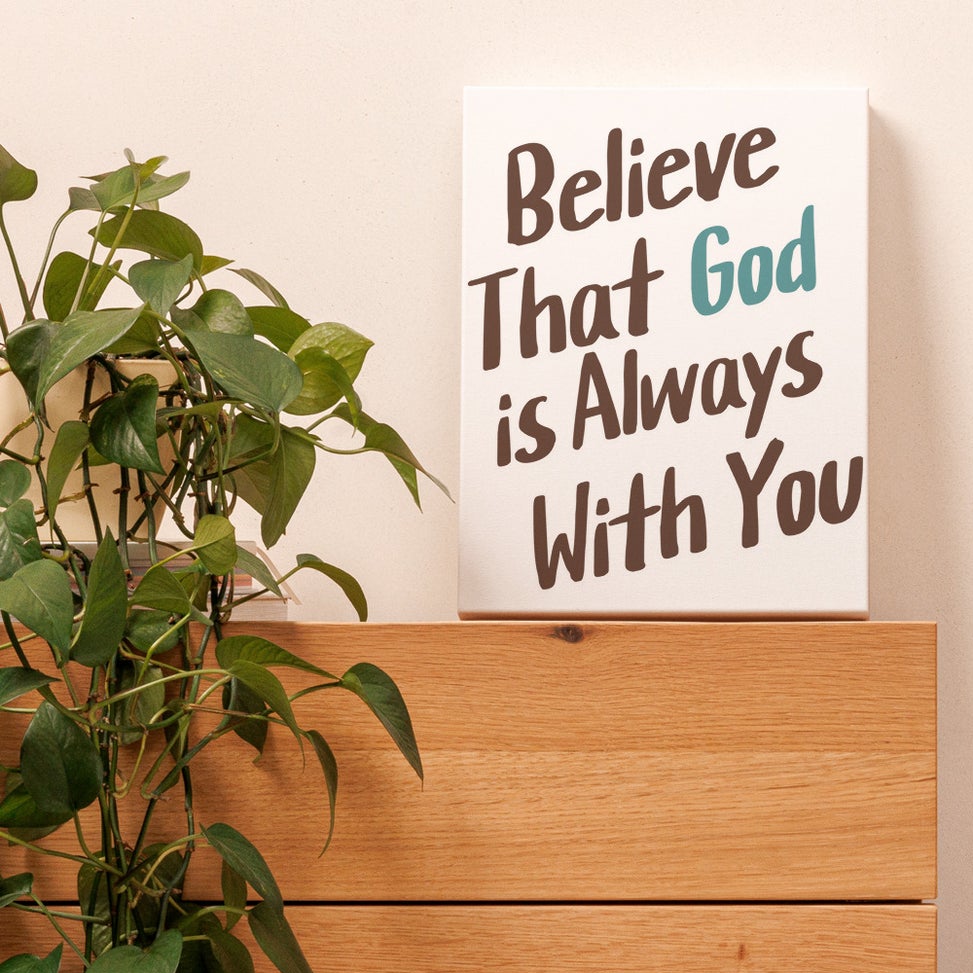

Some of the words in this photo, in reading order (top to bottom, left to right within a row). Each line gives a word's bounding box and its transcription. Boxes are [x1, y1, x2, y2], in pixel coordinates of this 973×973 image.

[507, 127, 780, 247] Believe
[467, 237, 665, 372] That
[691, 204, 817, 316] God
[497, 393, 557, 468] is
[572, 330, 824, 451] Always
[532, 466, 708, 591] With
[725, 437, 864, 549] You
